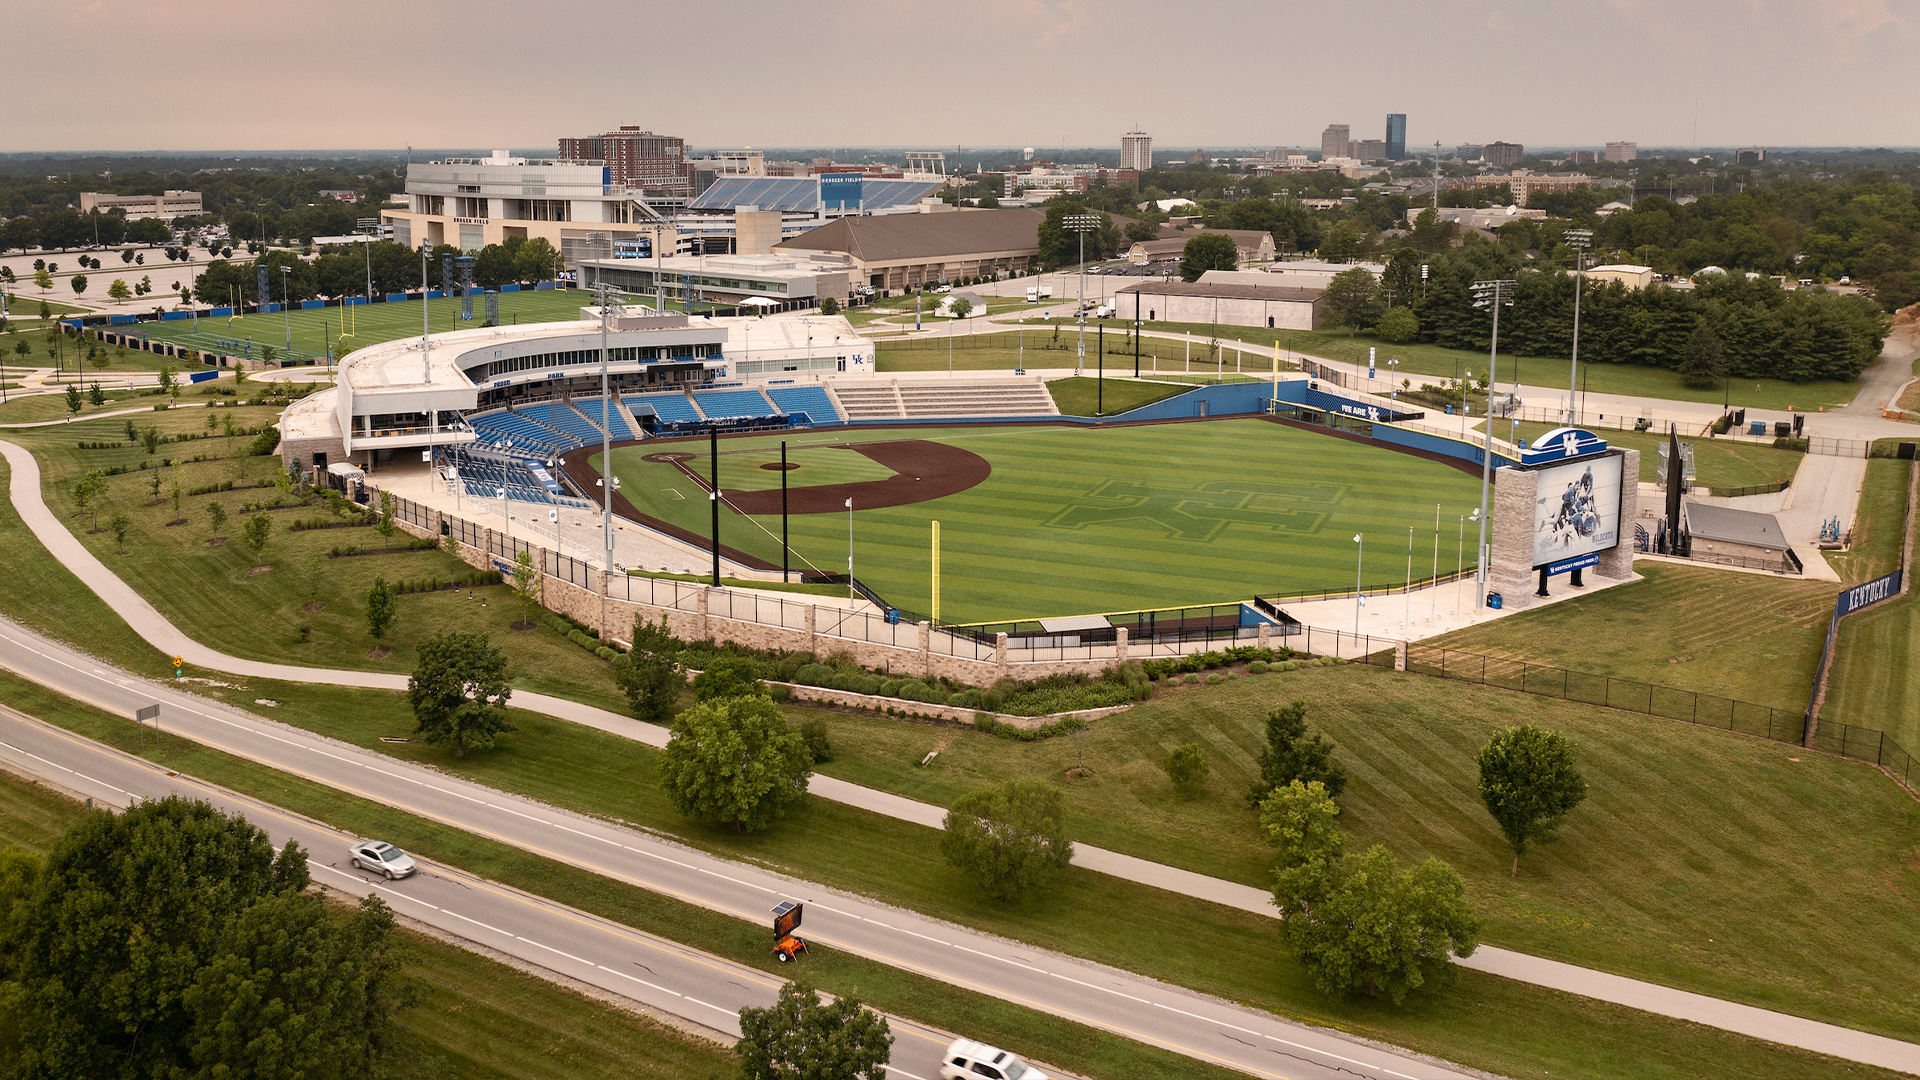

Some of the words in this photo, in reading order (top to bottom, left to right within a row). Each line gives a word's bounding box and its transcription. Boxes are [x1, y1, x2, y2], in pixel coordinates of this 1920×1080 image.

[547, 372, 565, 380] PARK
[493, 379, 511, 388] PROUD
[1342, 405, 1352, 413] WE
[1353, 406, 1366, 415] ARE
[1368, 406, 1379, 421] UK
[1562, 432, 1580, 456] UK
[1591, 531, 1614, 543] WILDCATS
[1848, 577, 1890, 611] KENTUCKY
